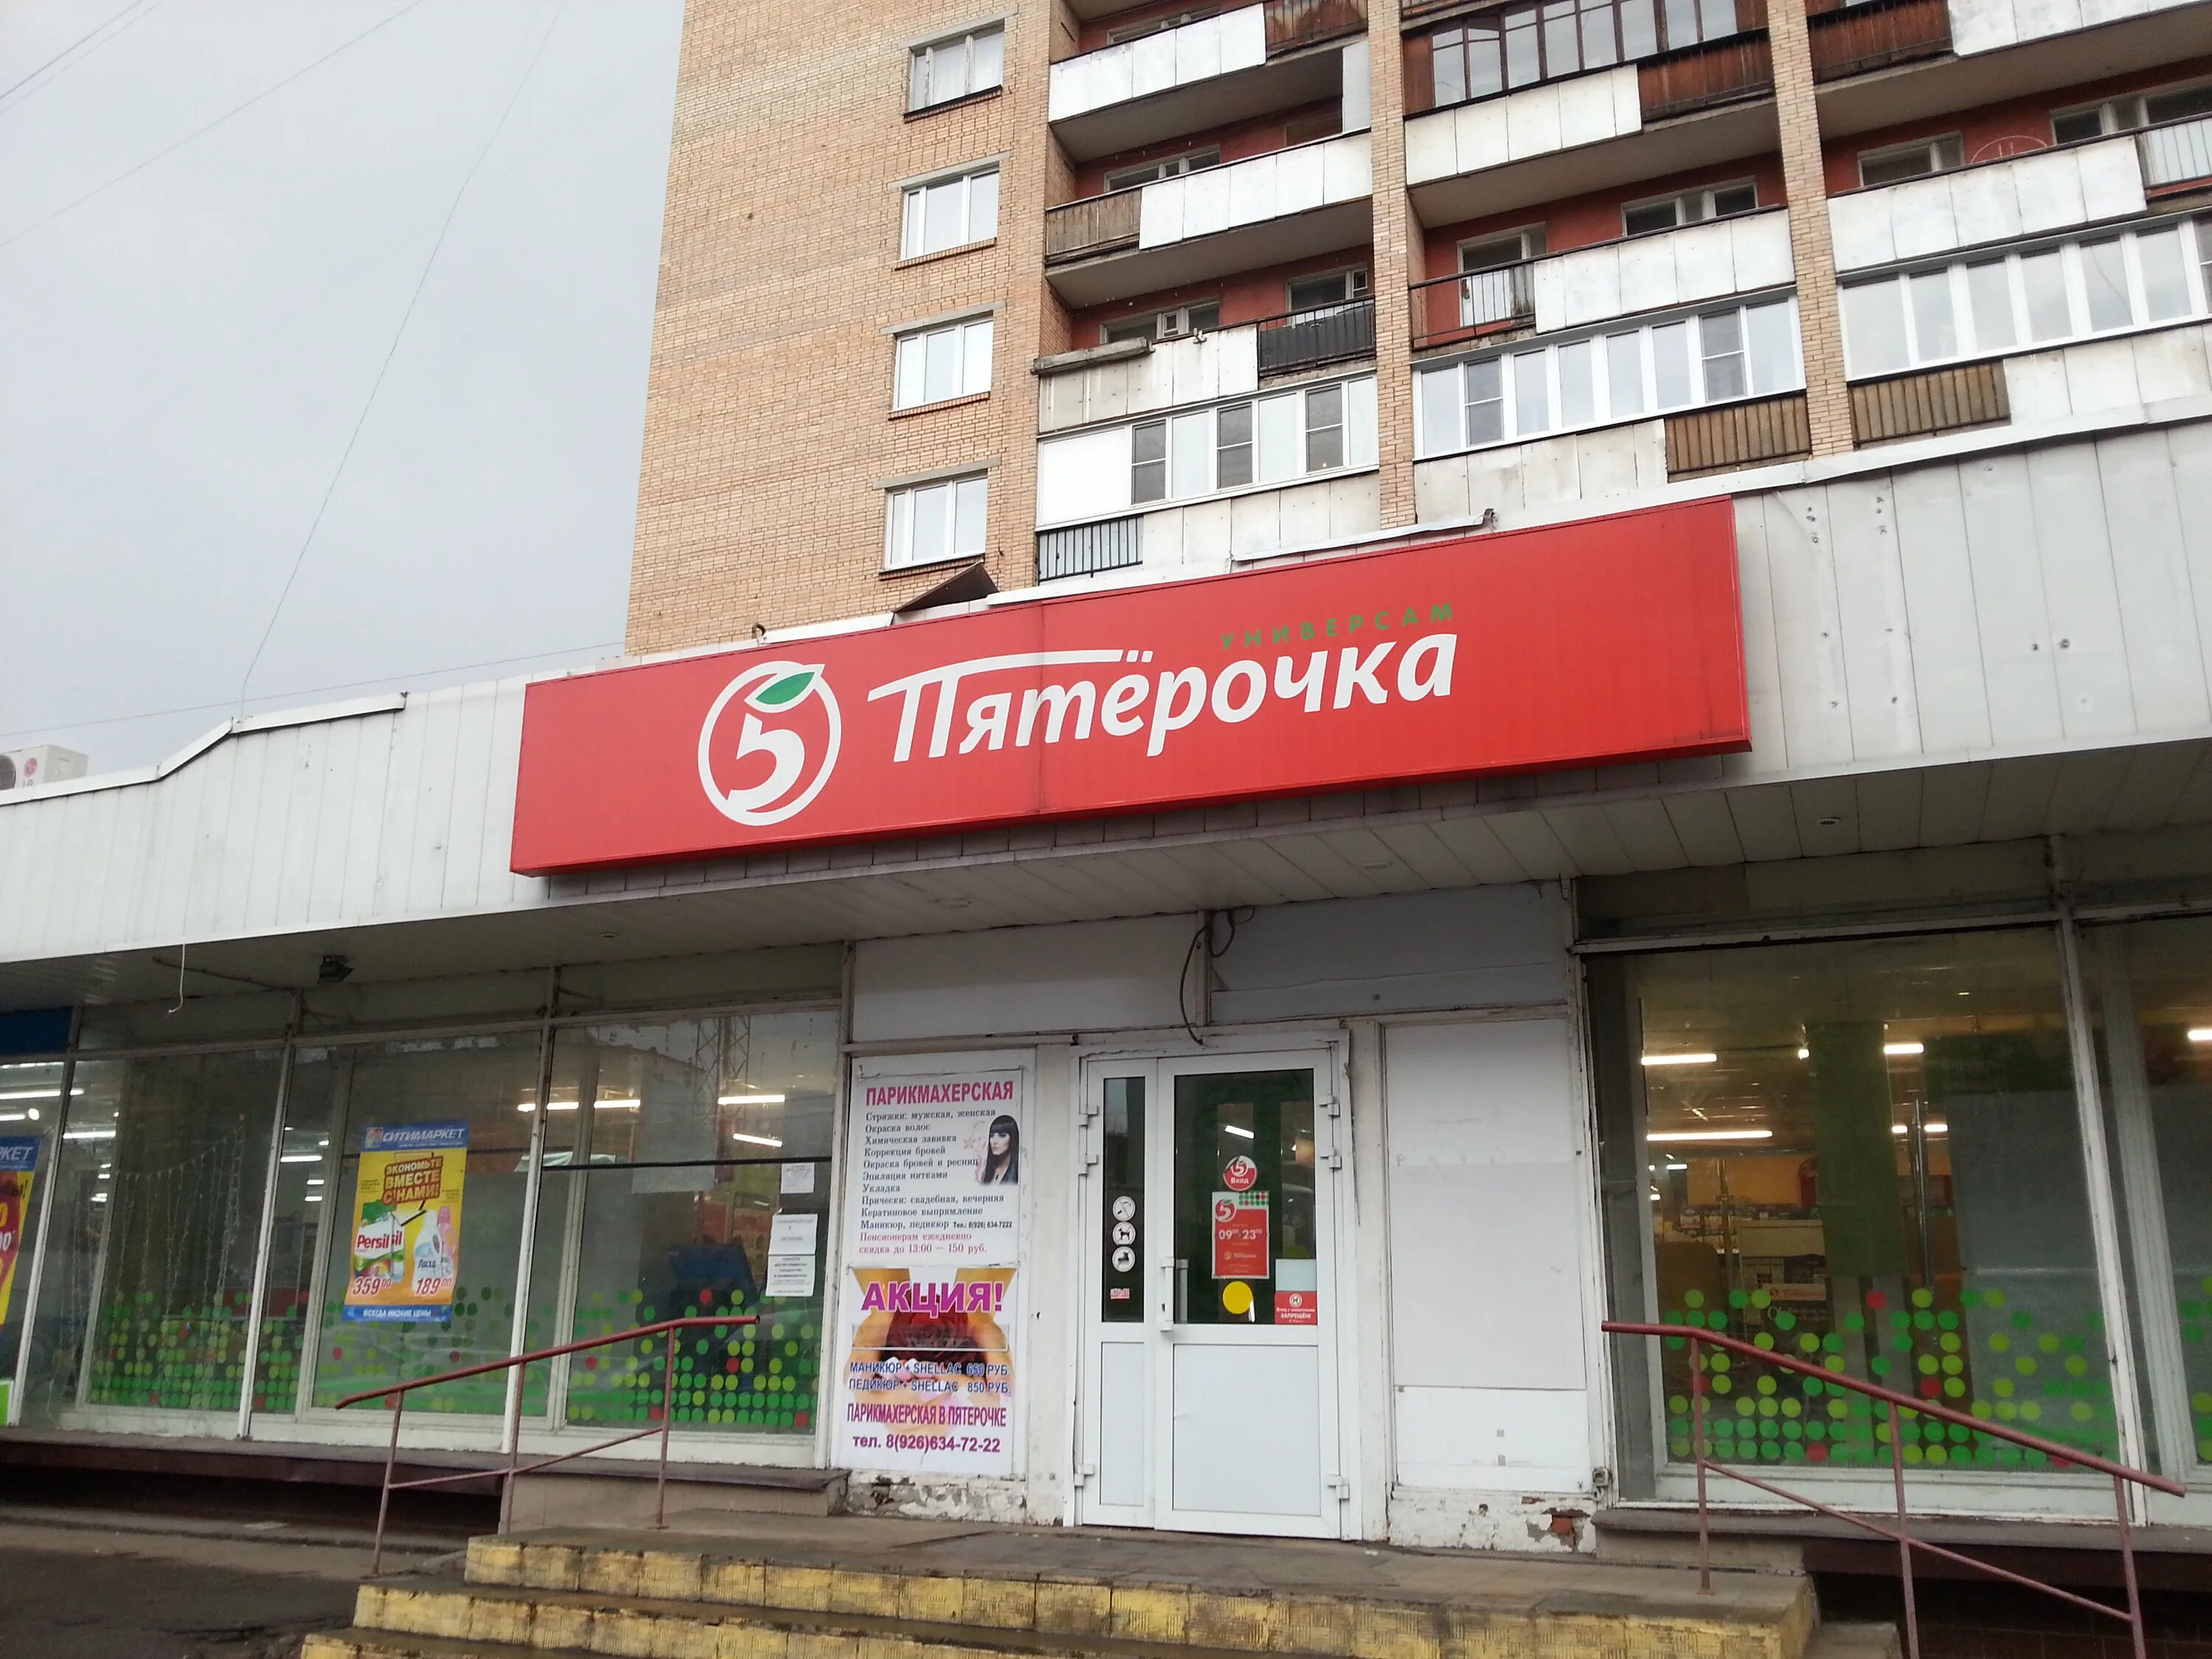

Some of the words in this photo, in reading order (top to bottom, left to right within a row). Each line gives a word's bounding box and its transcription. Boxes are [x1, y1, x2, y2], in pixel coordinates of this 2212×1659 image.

[1220, 602, 1453, 650] УНИВЕРСАМ
[868, 633, 1458, 762] Пятёрочка
[866, 1081, 1014, 1106] ПАРИКМАХЕРСКАЯ
[866, 1112, 908, 1122] Стрижки:
[911, 1111, 953, 1120] мужская,
[957, 1109, 995, 1117] женская
[383, 1128, 465, 1142] СИТИМАРКЕТ
[865, 1124, 901, 1134] Окраска
[865, 1136, 918, 1145] Химическая
[864, 1148, 911, 1159] Коррекция
[915, 1147, 946, 1158] бровей
[386, 1158, 442, 1175] ЭКОНОМЬТЕ
[863, 1160, 900, 1170] Окраска
[903, 1158, 933, 1169] бровей
[947, 1158, 978, 1168] ресниц
[384, 1169, 440, 1189] ВМЕСТЕ
[863, 1172, 906, 1181] Эпиляция
[910, 1172, 947, 1180] нитками
[1231, 1177, 1249, 1185] Вход
[397, 1184, 440, 1202] НАМИ!
[863, 1184, 900, 1193] Укладка
[862, 1196, 906, 1206] Прически:
[910, 1194, 959, 1205] свадебная,
[962, 1195, 1004, 1204] вечерняя
[861, 1208, 917, 1218] Кератиновое
[922, 1208, 983, 1218] выпрямление
[860, 1220, 905, 1231] Маникюр,
[910, 1221, 949, 1230] педикюр
[356, 1234, 390, 1249] Persil
[860, 1232, 918, 1242] Пенсионерам
[922, 1233, 972, 1242] ежедневно
[859, 1245, 890, 1254] скидка
[893, 1246, 905, 1254] до
[908, 1244, 932, 1253] 13:00
[948, 1244, 964, 1253] 150
[968, 1244, 987, 1255] руб.
[860, 1281, 1004, 1318] АКЦИЯ!
[363, 1309, 386, 1318] ВСЕГДА
[849, 1362, 902, 1374] МАНИКЮР
[914, 1363, 962, 1375] SHELLAC
[987, 1364, 1011, 1377] РУБ.
[849, 1379, 901, 1391] ПЕДИКЮР
[911, 1380, 959, 1393] SHELLAC
[967, 1381, 985, 1394] 850
[988, 1382, 1012, 1394] РУБ.
[847, 1403, 936, 1425] ПАРИКМАХЕРСКАЯ
[939, 1405, 946, 1425] В
[948, 1406, 1007, 1427] ПЯТЕРОЧКЕ
[852, 1436, 882, 1448] тел.
[886, 1433, 1001, 1454] 8(926)634-72-22
